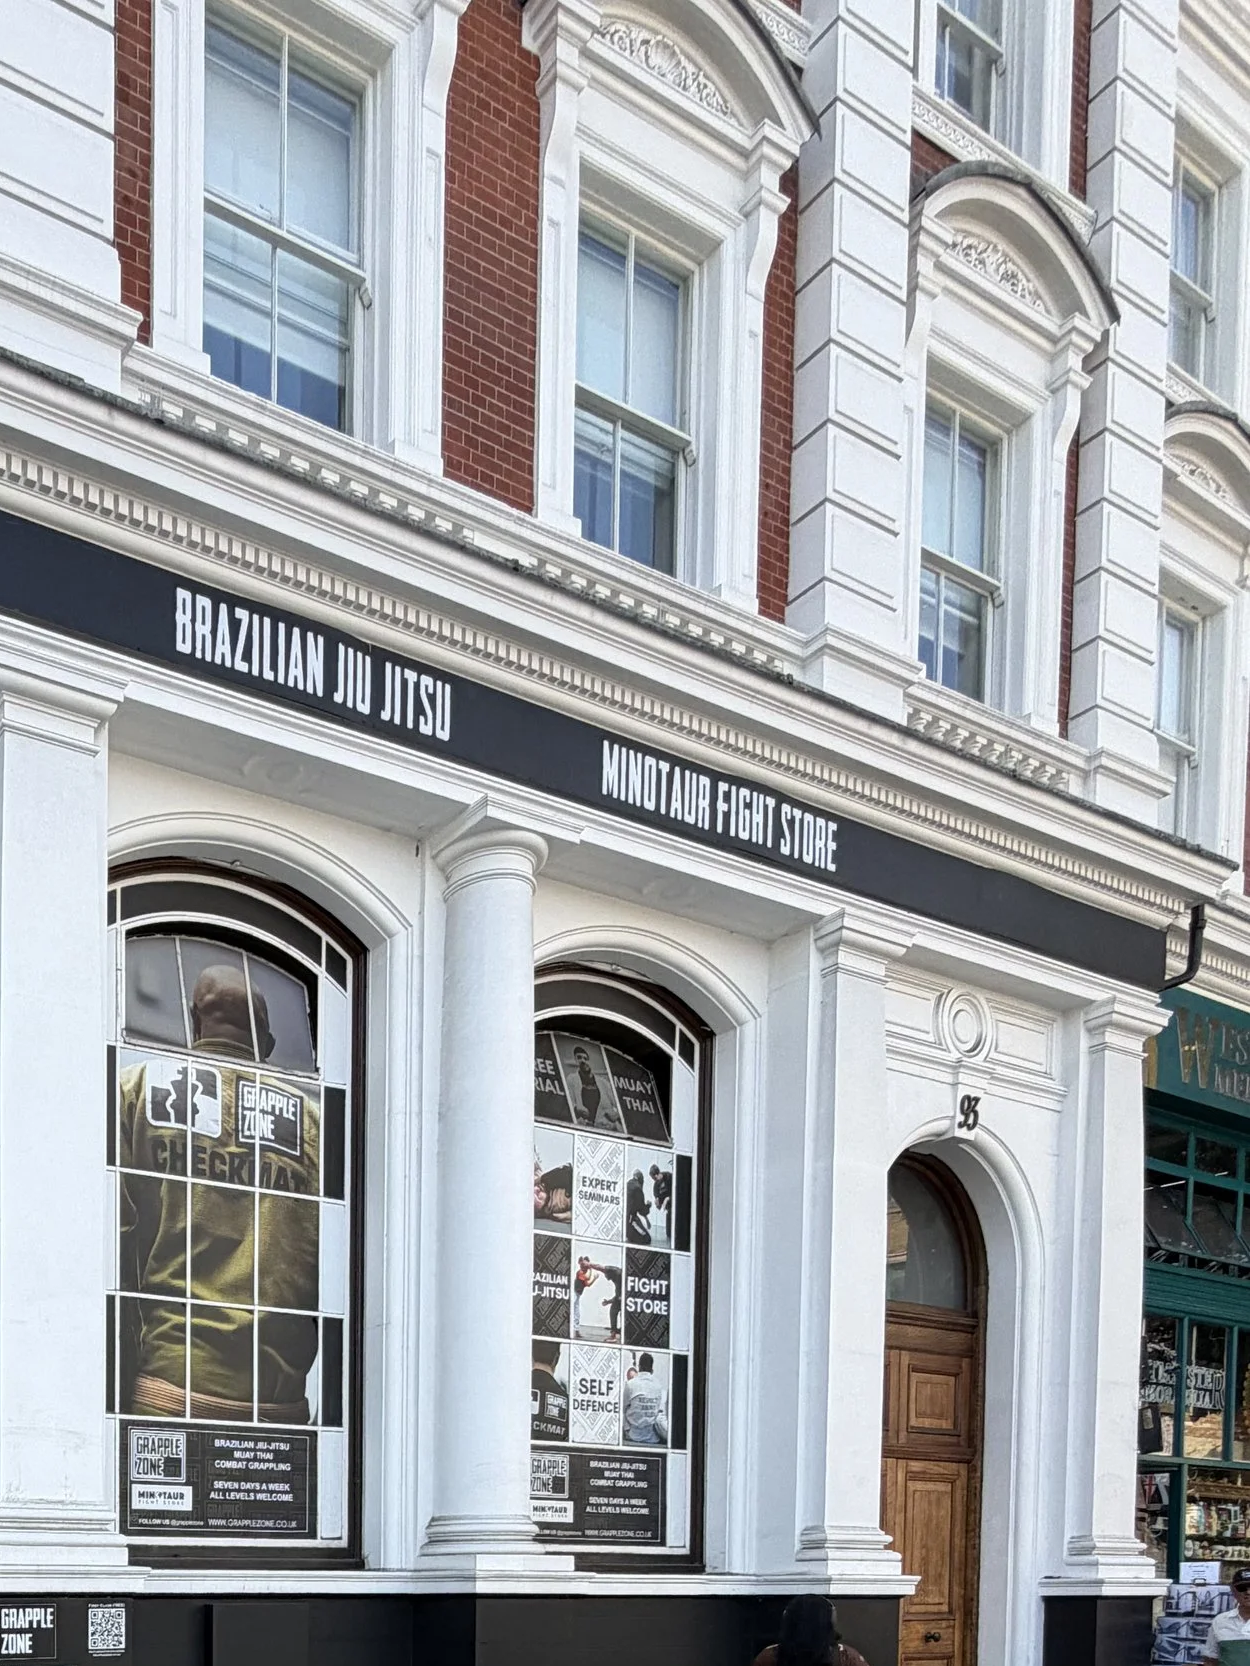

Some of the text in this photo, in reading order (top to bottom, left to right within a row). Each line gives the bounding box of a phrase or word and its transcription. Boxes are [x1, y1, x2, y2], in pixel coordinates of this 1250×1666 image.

[175, 587, 451, 742] BRAZILIAN JIU JITSU
[602, 740, 837, 872] MINOTAUR FIGHT STORE
[535, 1077, 565, 1095] RIAL
[614, 1076, 651, 1094] MUAY
[623, 1096, 655, 1114] THAI
[957, 1094, 981, 1131] 93
[582, 1176, 618, 1192] EXPERT
[578, 1190, 620, 1205] SEMINARS
[532, 1272, 568, 1285] RAZILIAN
[627, 1276, 668, 1295] FIGHT
[626, 1297, 668, 1315] STORE
[579, 1378, 614, 1396] SELF
[573, 1399, 619, 1414] DEFENCE
[532, 1421, 566, 1436] CKMAT
[136, 1436, 182, 1456] GRAPPLE
[214, 1439, 289, 1450] BRAZILIAN JIU-JITSU
[234, 1451, 273, 1460] MUAY THAI
[136, 1457, 164, 1476] ZONE
[215, 1460, 291, 1471] COMBAT GRAPPLING
[590, 1461, 620, 1469] BRAZILIAN
[214, 1481, 239, 1489] SEVEN
[240, 1482, 260, 1490] DAYS
[268, 1483, 290, 1491] WEEK
[615, 1480, 647, 1488] GRAPPLING
[210, 1491, 293, 1501] ALL LEVELS WELCOME
[586, 1505, 649, 1515] ALL LEVELS WELCOME
[207, 1518, 297, 1528] WWW.GRAPPLEZONE.CO.UK
[1, 1608, 54, 1629] GRAPPLE
[1, 1634, 33, 1654] ZONE
